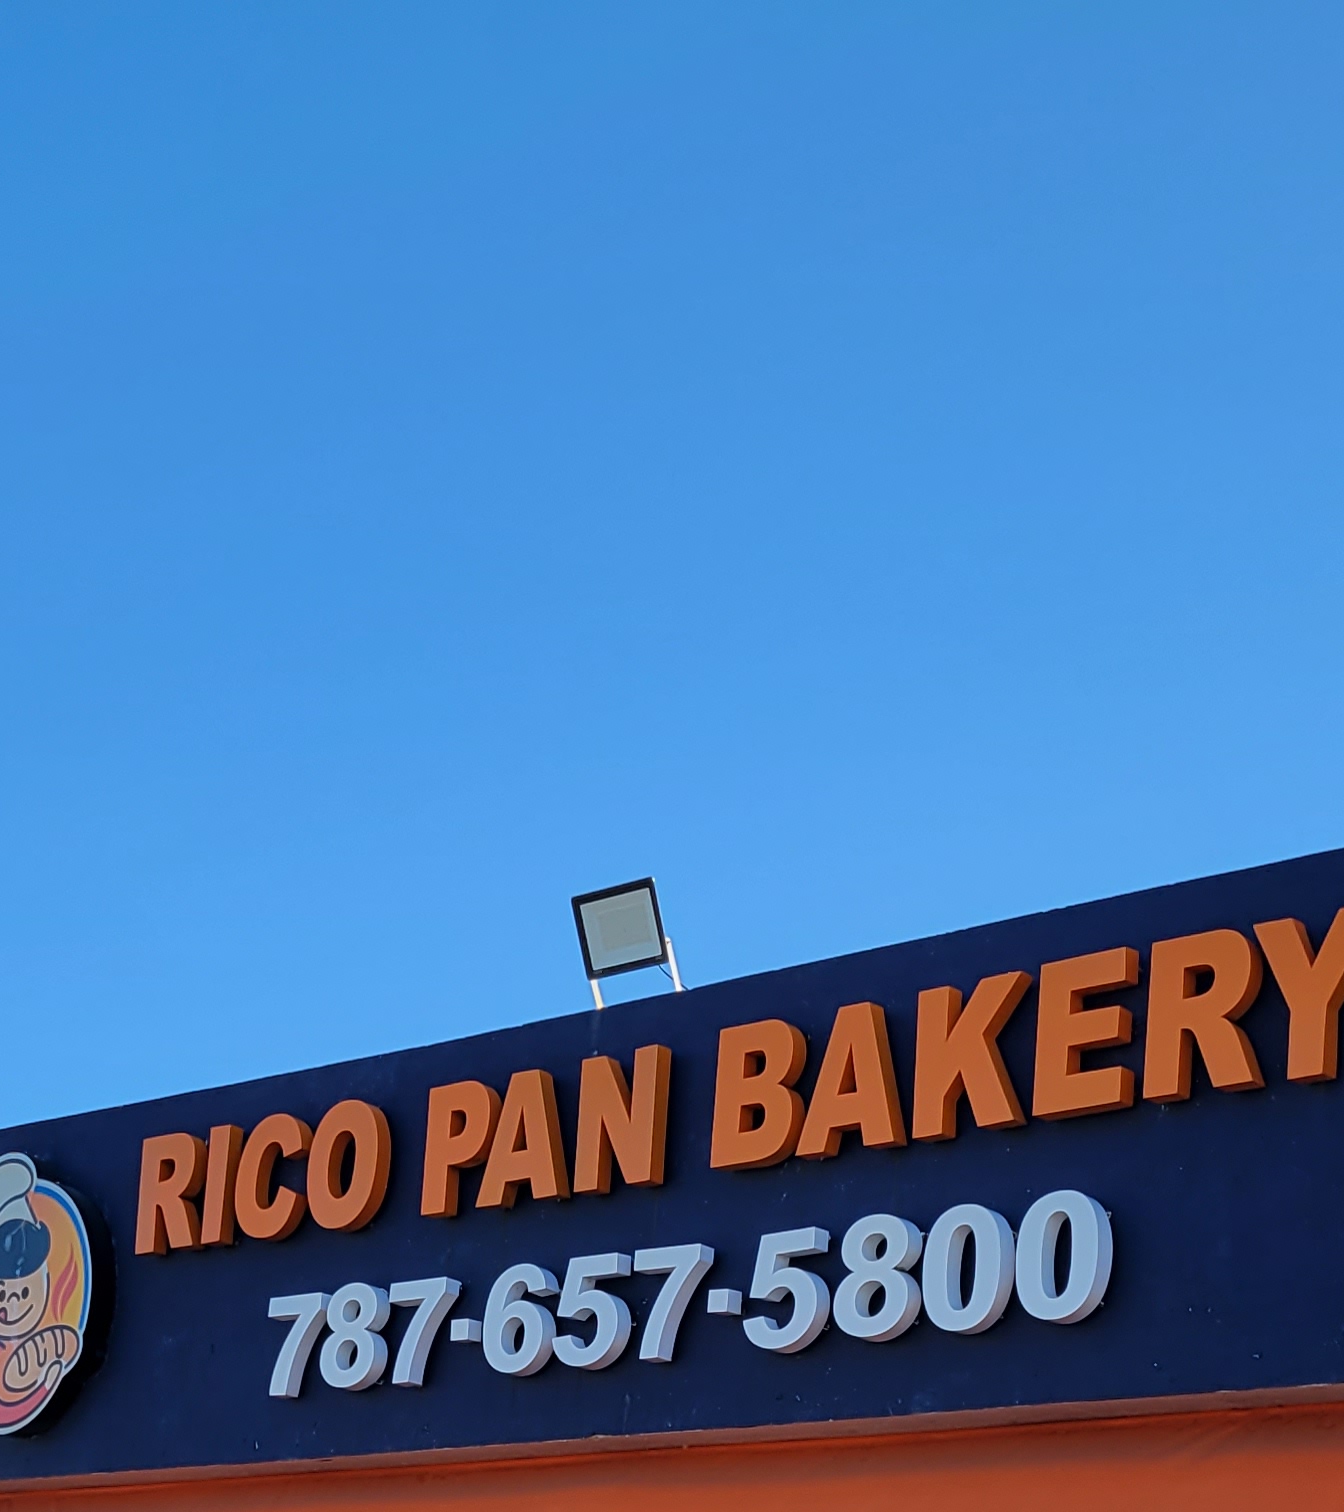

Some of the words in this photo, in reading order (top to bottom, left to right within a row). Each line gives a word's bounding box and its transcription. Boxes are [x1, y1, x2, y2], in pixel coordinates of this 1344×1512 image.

[134, 1099, 391, 1255] RICO
[420, 1044, 672, 1217] PAN
[267, 1189, 1113, 1399] 787-657-5800
